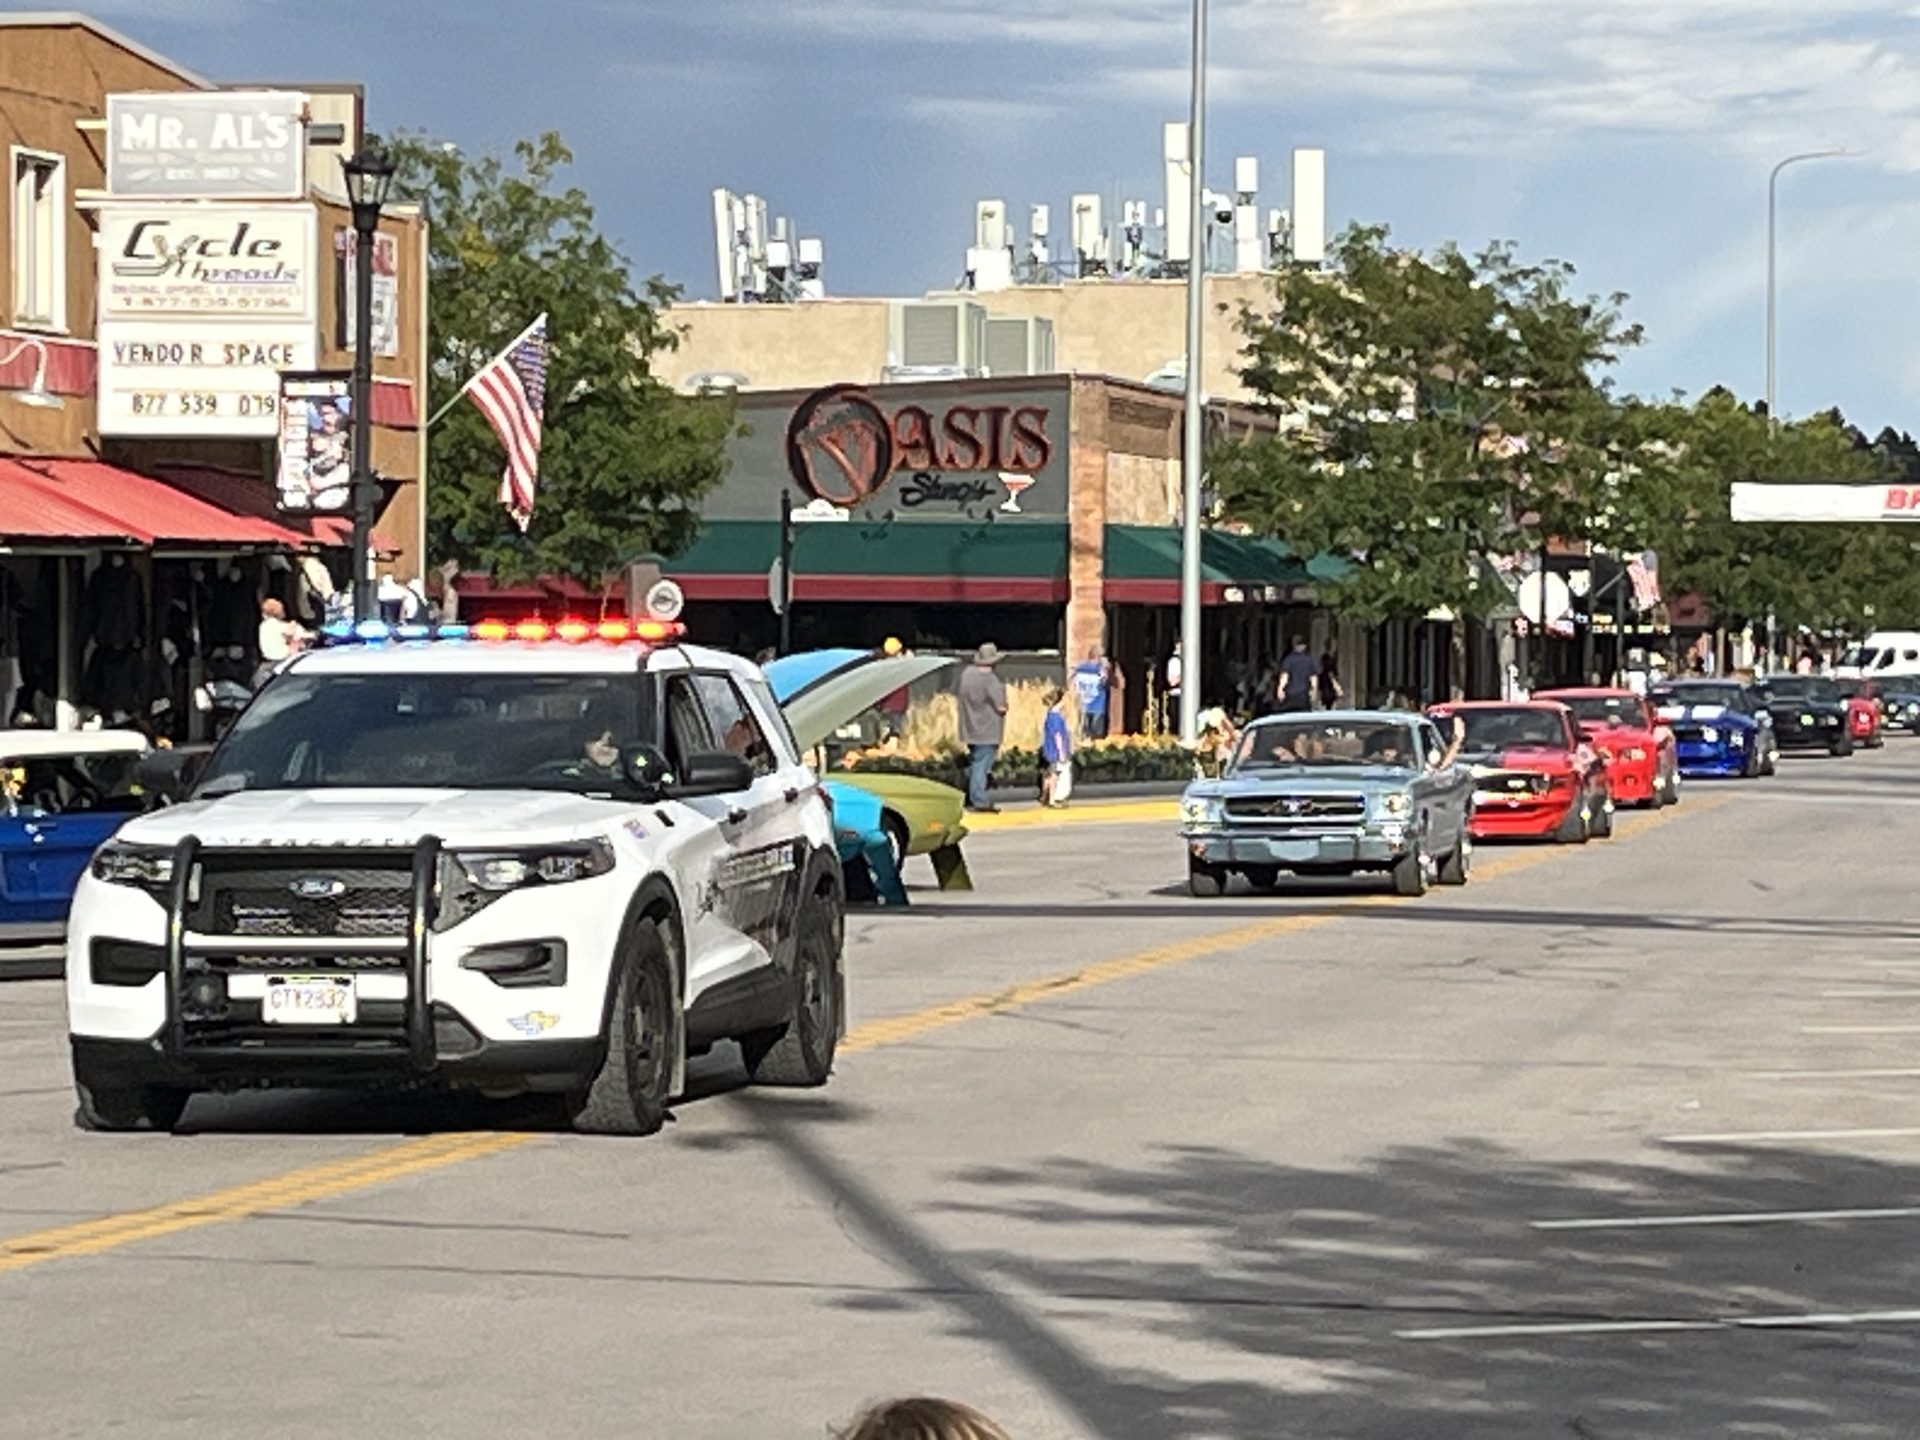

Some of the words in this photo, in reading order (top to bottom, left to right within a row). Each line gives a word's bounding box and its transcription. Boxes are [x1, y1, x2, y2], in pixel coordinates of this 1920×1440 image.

[120, 112, 197, 149] MR.
[211, 110, 289, 149] AL'S
[112, 220, 282, 277] Cycle
[223, 343, 294, 364] SPACE
[179, 393, 217, 415] 539
